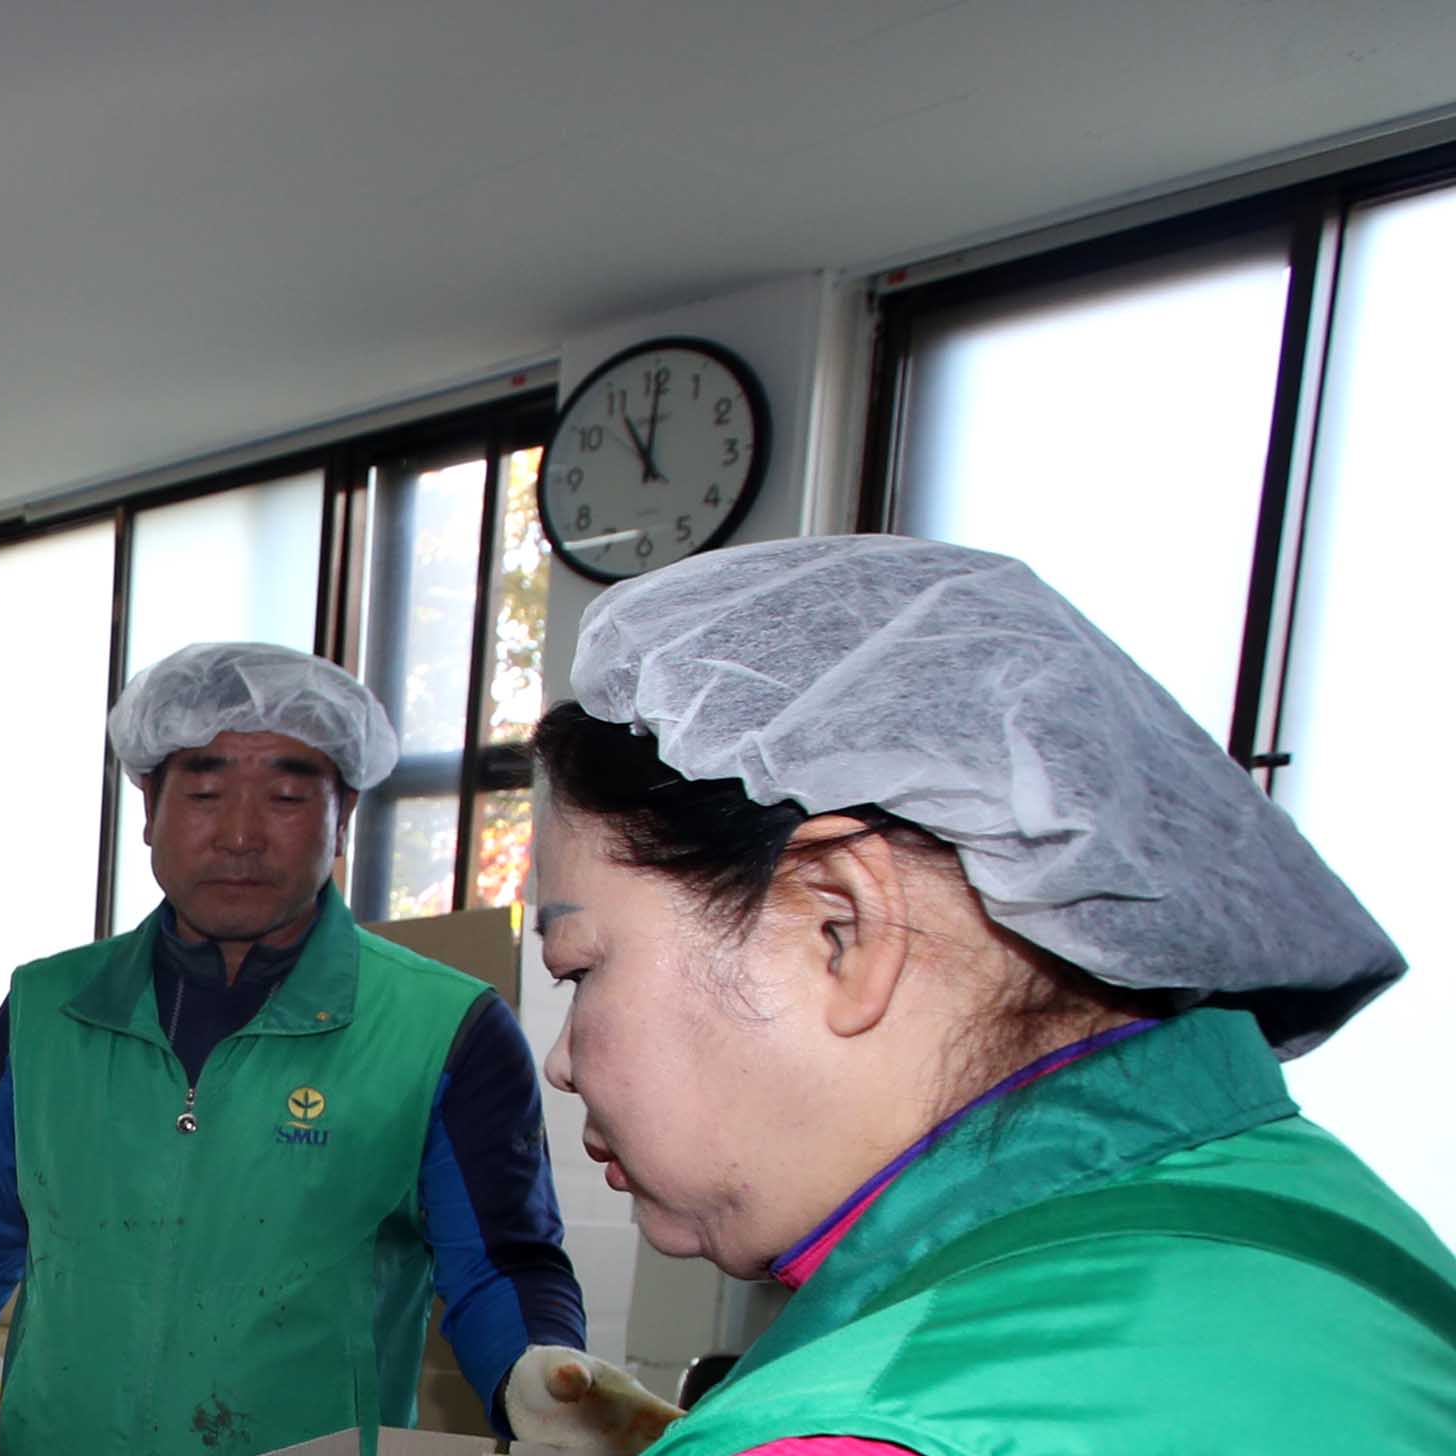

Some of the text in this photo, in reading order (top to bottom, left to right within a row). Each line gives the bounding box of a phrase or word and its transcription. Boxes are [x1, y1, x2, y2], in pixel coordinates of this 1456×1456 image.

[643, 366, 670, 397] 12
[690, 373, 701, 398] 1
[608, 389, 628, 418] 11
[714, 397, 733, 425] 2
[578, 425, 604, 452] 10
[722, 438, 739, 467] 3
[566, 467, 584, 492] 9
[703, 483, 721, 508] 4
[576, 505, 592, 531] 8
[675, 514, 692, 542] 5
[637, 532, 654, 558] 6
[274, 1127, 329, 1146] SMU
